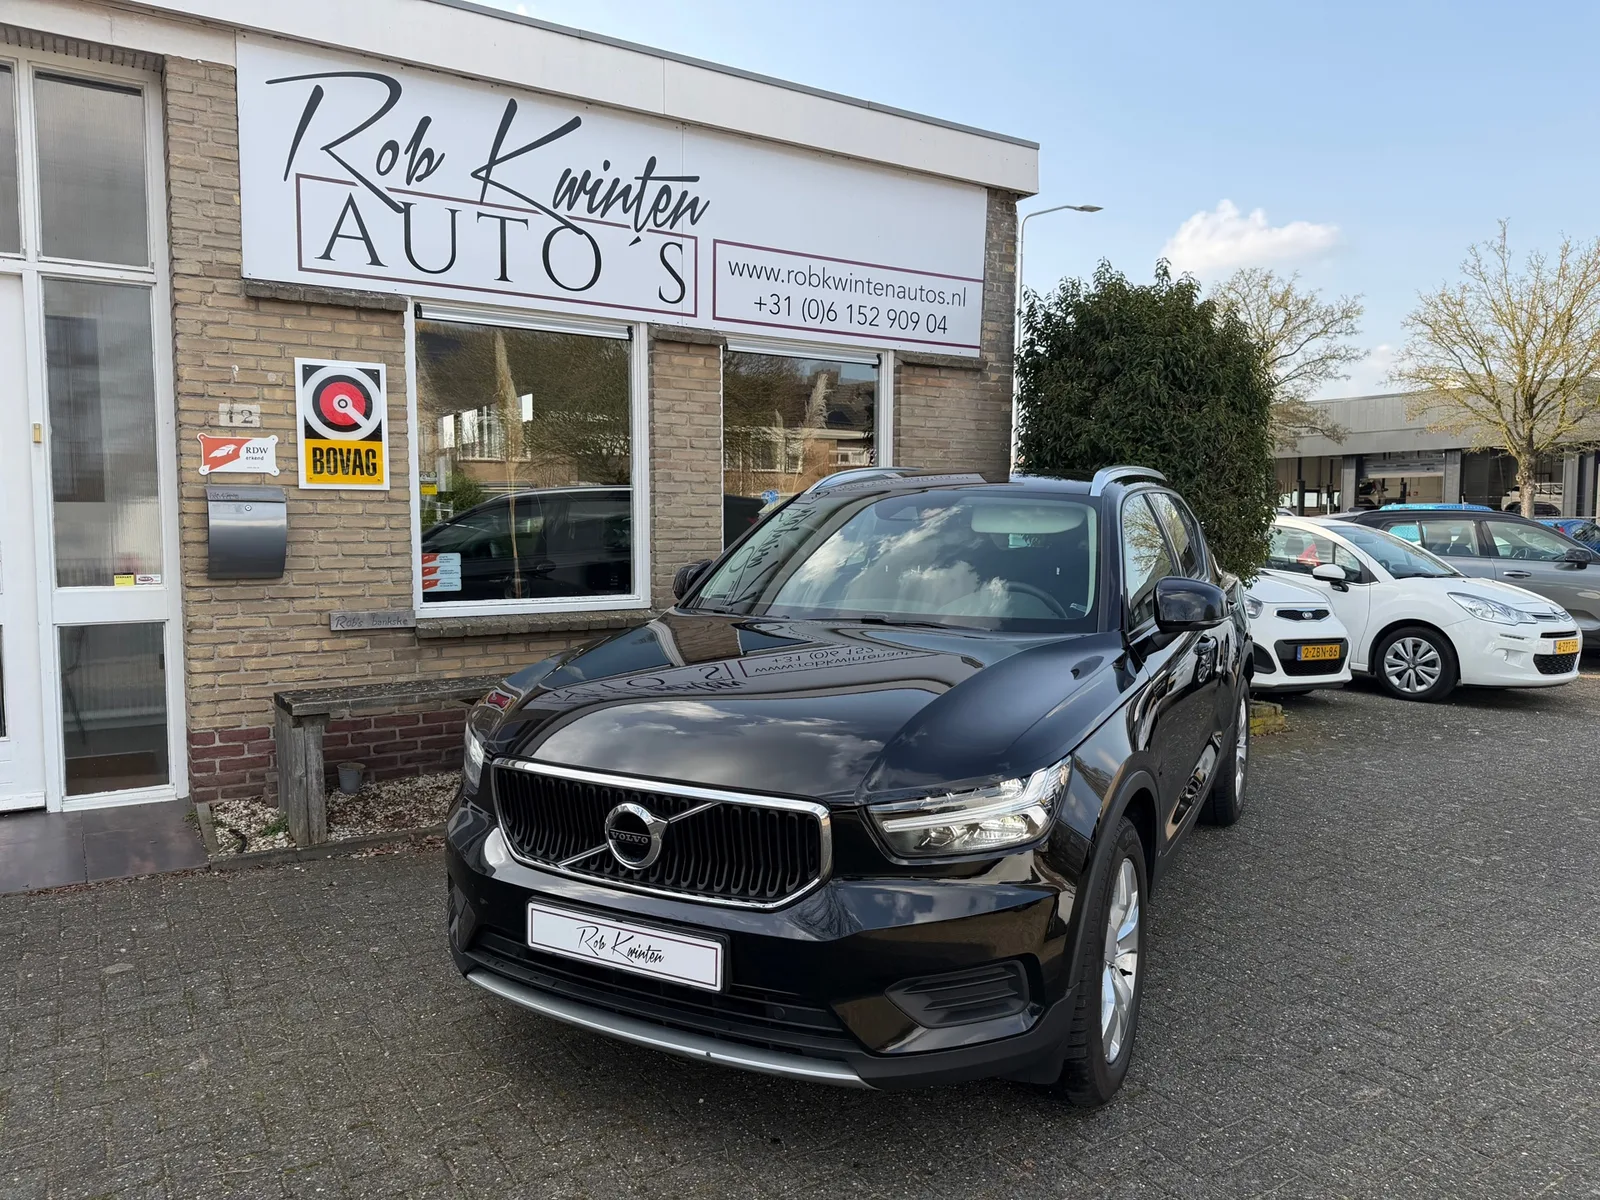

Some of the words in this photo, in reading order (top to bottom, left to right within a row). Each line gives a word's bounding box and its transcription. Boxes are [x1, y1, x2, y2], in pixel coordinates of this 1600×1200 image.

[265, 70, 446, 214] Rob
[470, 97, 711, 234] Kwinten
[728, 260, 967, 308] www.robkwintenautos.nl
[753, 293, 792, 317] +31
[801, 297, 838, 324] (0)6
[846, 303, 880, 327] 152
[886, 308, 921, 333] 909
[926, 314, 949, 335] 04
[245, 446, 269, 454] RDW
[311, 446, 378, 477] BOVAG
[335, 615, 364, 629] Rob's
[1303, 646, 1338, 658] 2-ZBN-86
[610, 830, 650, 845] VOLVO
[576, 924, 607, 956] Rob
[610, 930, 665, 965] Kwinten
